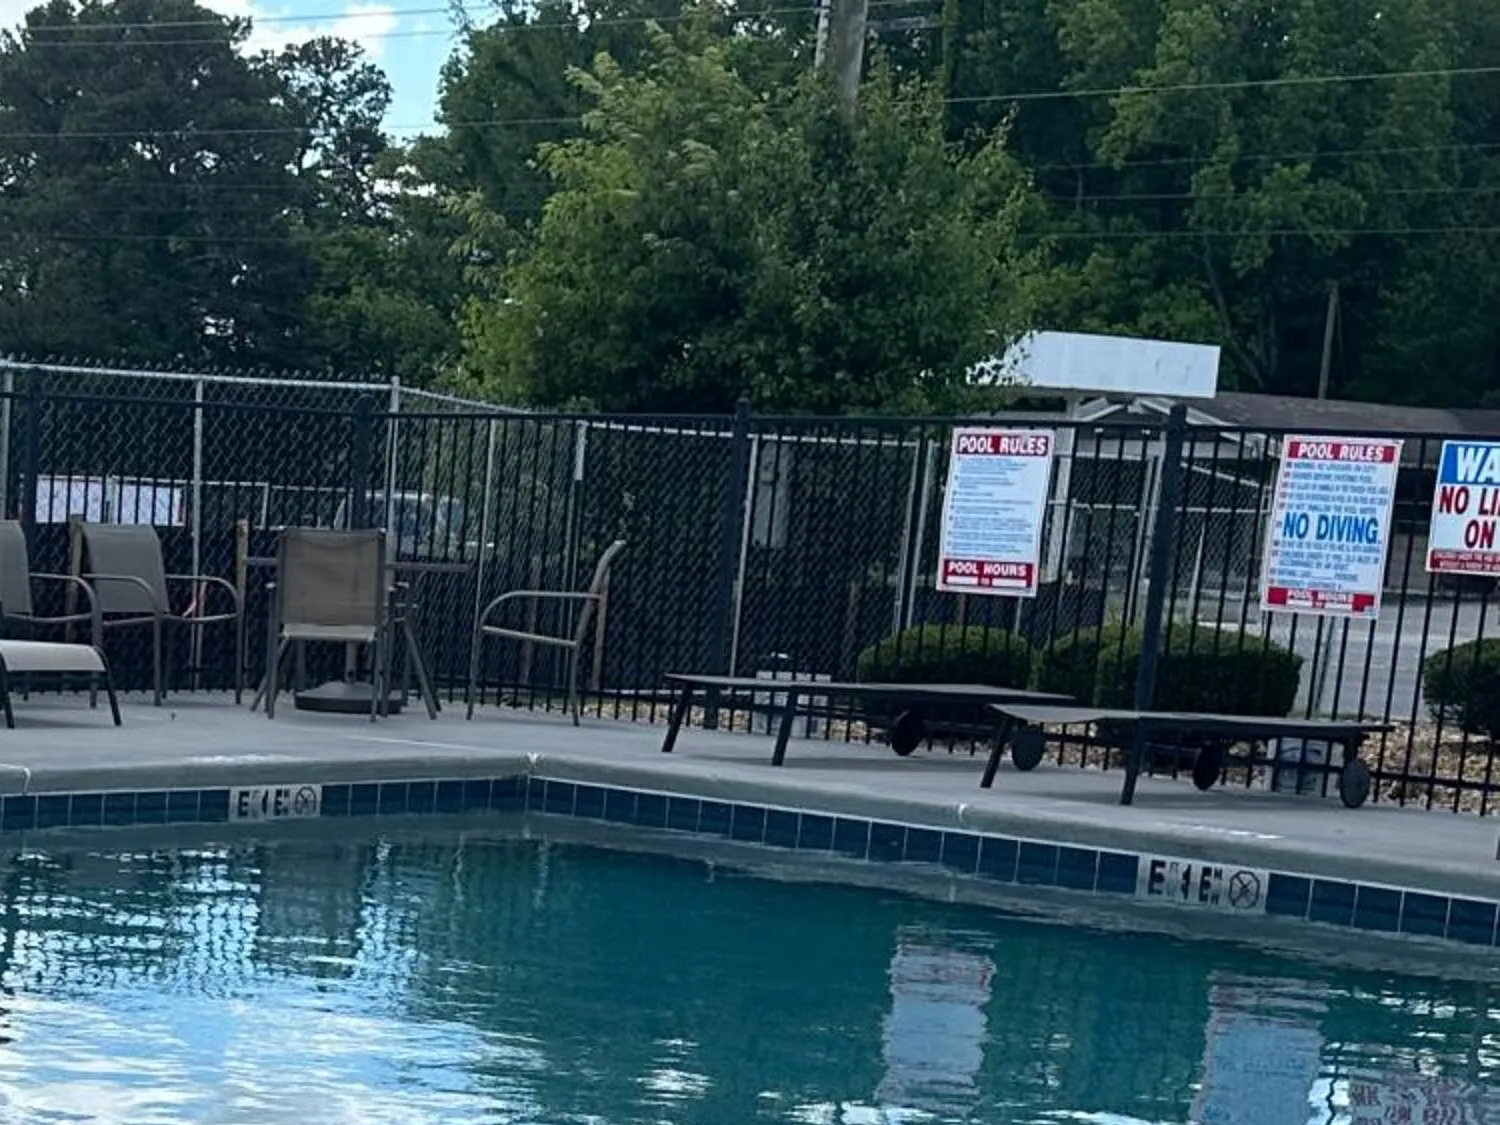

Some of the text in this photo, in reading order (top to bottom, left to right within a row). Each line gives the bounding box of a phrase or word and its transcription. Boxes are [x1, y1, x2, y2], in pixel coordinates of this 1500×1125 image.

[959, 436, 1047, 455] POOL RULES
[1298, 443, 1385, 461] POOL RULES
[1439, 485, 1500, 516] NO LI
[1283, 512, 1309, 539] NO
[1464, 519, 1496, 549] ON
[948, 561, 980, 574] POOL
